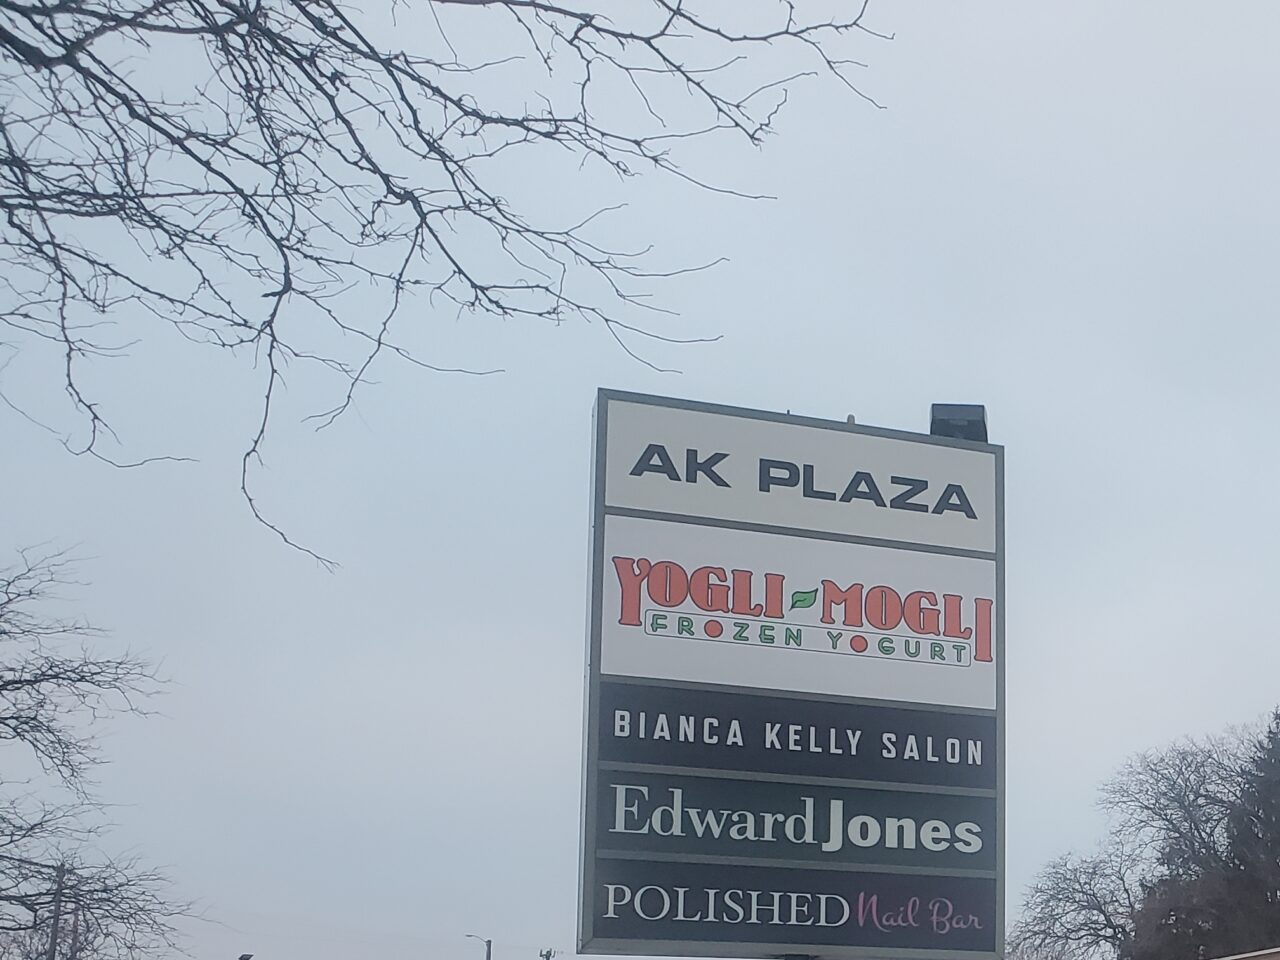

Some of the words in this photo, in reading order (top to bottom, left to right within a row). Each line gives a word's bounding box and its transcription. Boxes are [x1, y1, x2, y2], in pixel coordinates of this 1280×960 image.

[629, 443, 732, 488] AK
[758, 457, 978, 520] PLAZA
[612, 556, 785, 627] YOGLI
[820, 578, 994, 662] MOGLI
[650, 614, 802, 646] FROZEN
[827, 631, 968, 662] YOGURT
[613, 709, 744, 747] BIANCA
[764, 722, 862, 755] KELLY
[881, 732, 984, 765] SALON
[602, 884, 850, 928] POLISHED
[857, 891, 920, 933] Nail
[928, 897, 983, 934] Bar
